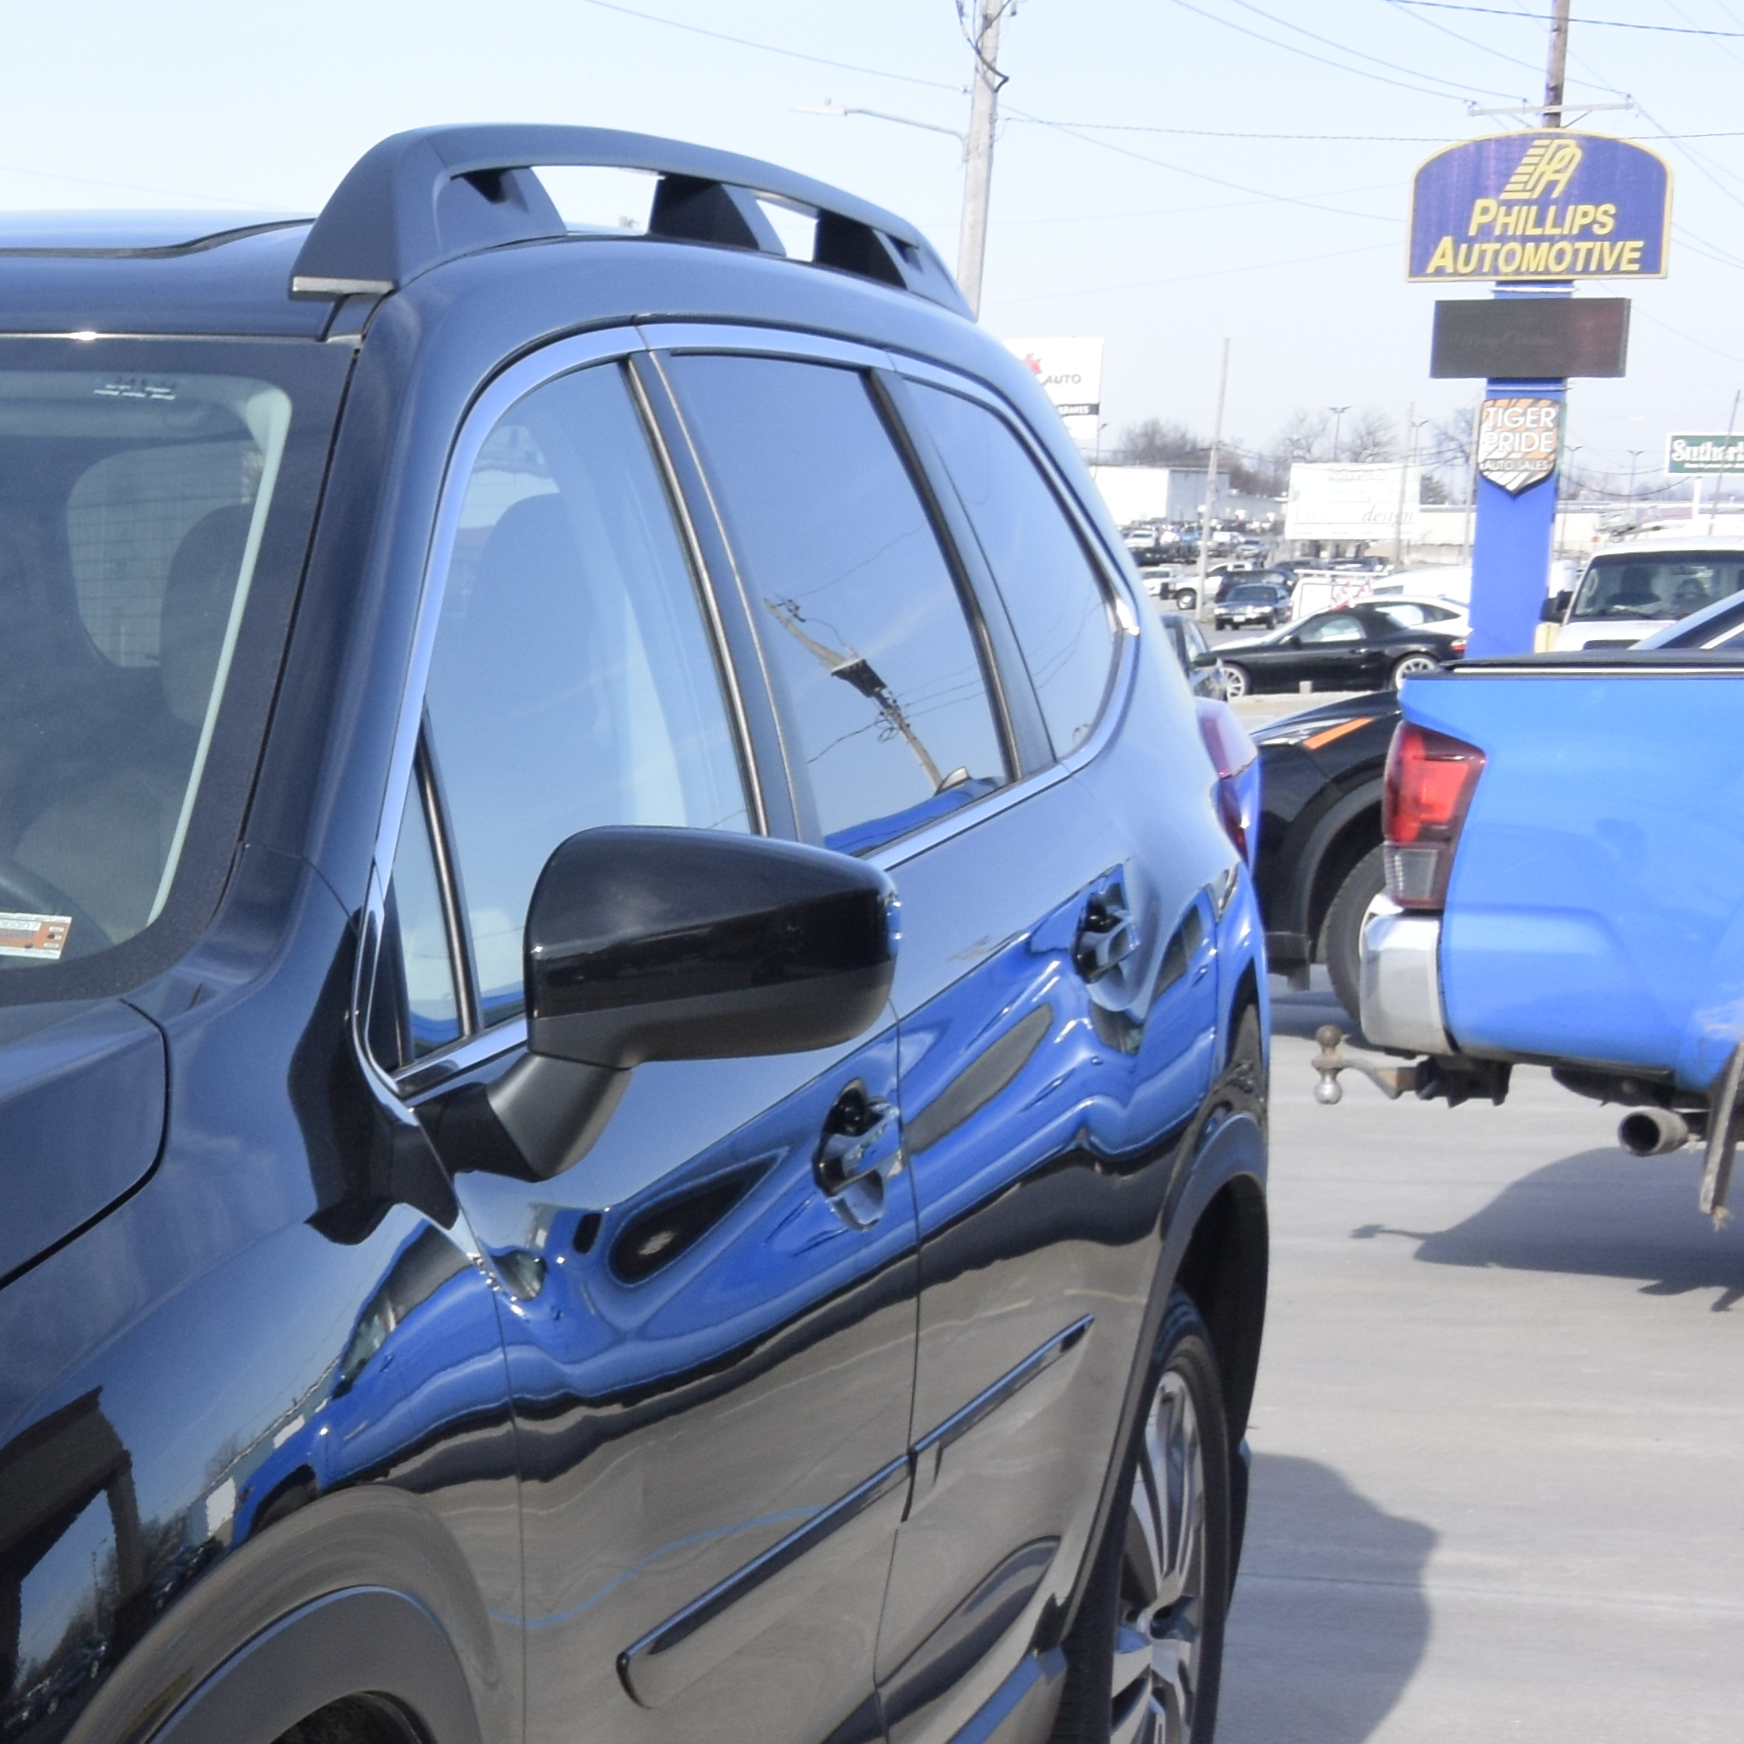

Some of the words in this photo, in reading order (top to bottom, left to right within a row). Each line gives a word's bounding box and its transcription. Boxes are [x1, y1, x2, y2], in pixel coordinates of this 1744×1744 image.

[1468, 198, 1616, 236] PHILLIPS
[1426, 236, 1645, 274] AUTOMOTIVE
[1041, 373, 1082, 386] AUTO
[1486, 407, 1557, 429] TIGER
[1484, 431, 1555, 453] PRIDE
[1484, 460, 1514, 470] AUTO
[1517, 460, 1549, 470] SALES
